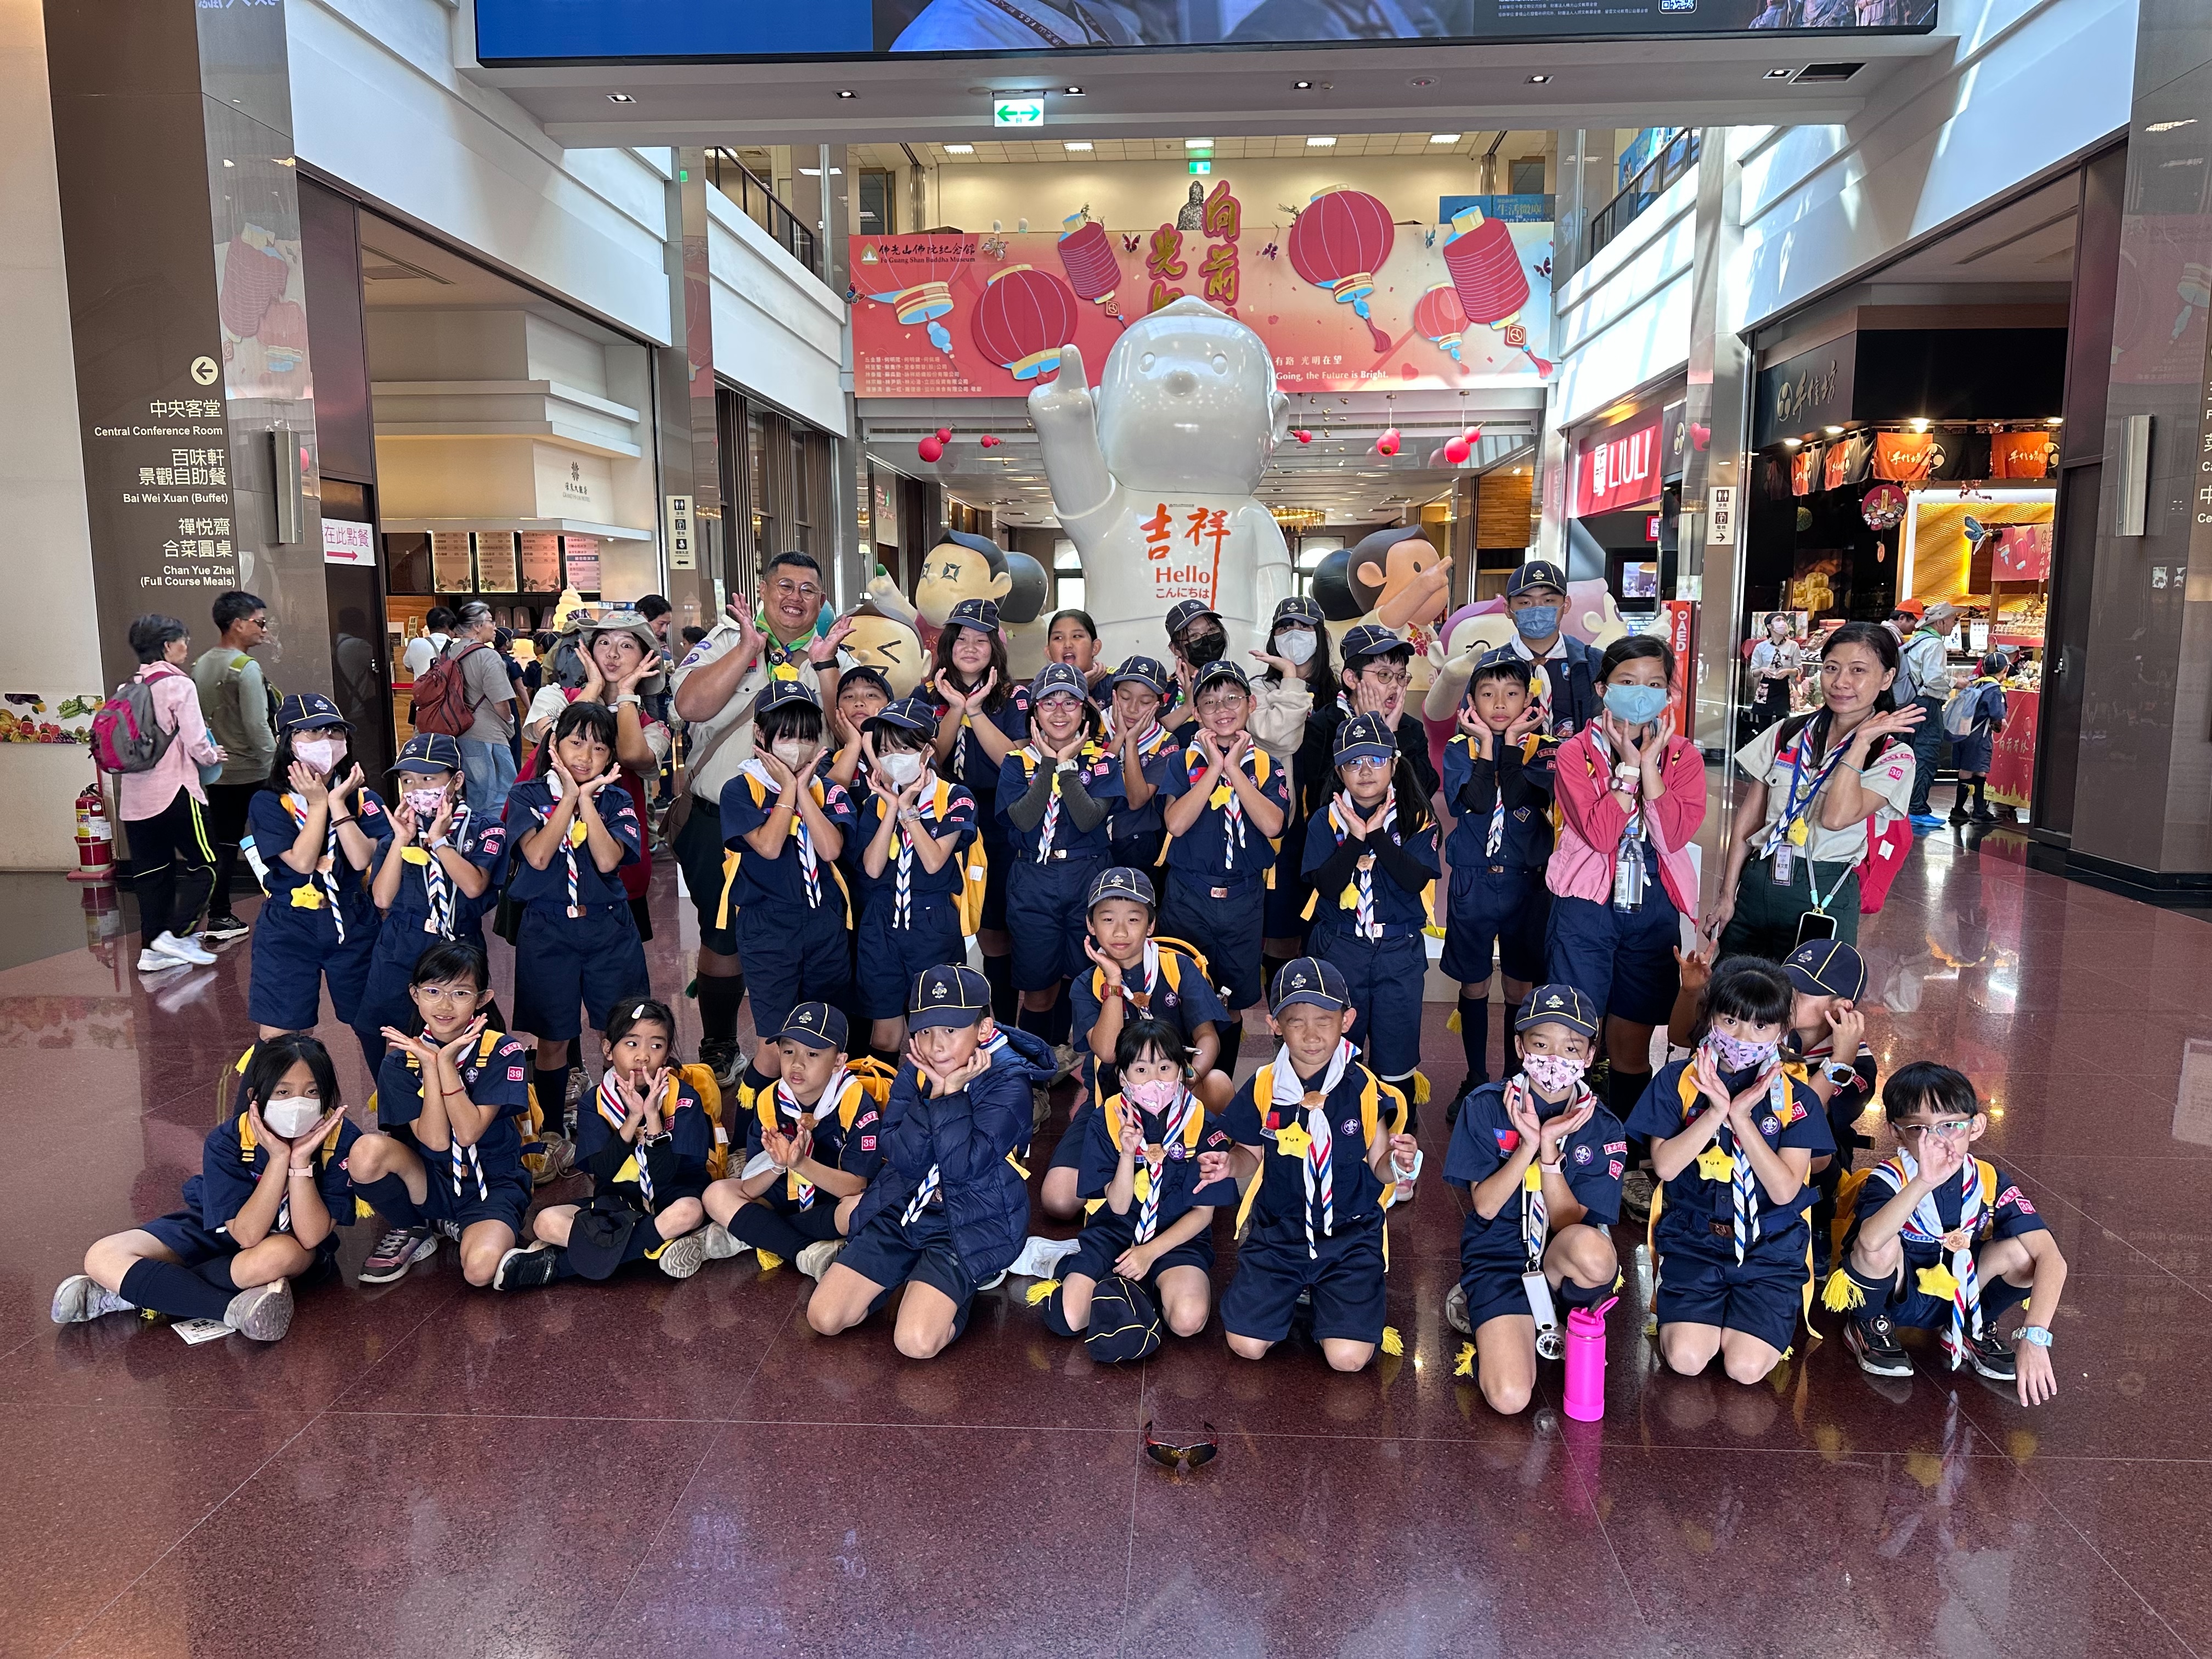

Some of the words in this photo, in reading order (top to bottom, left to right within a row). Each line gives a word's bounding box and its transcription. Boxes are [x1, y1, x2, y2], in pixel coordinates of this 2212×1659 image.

[1275, 356, 1295, 366] 有路
[1301, 356, 1342, 365] 光明在望
[1276, 372, 1304, 382] Going,
[1306, 371, 1319, 380] the
[1322, 371, 1349, 380] Future
[1361, 370, 1389, 381] Bright.
[150, 399, 221, 418] 中央客堂
[94, 426, 131, 437] Central
[132, 426, 190, 436] Conference
[193, 426, 223, 435] Room
[172, 448, 224, 467] 百味軒
[1609, 430, 1651, 488] LIULI
[138, 467, 227, 486] 景觀自助餐
[123, 493, 140, 503] Bai
[142, 493, 161, 503] Wei
[163, 493, 189, 503] Xuan
[191, 493, 228, 505] (Buffet)
[162, 539, 233, 558] 合菜圓桌
[1140, 503, 1231, 611] 吉祥
[163, 566, 189, 575] Chan
[191, 566, 210, 575] Yue
[212, 566, 234, 575] Zhai
[1155, 565, 1211, 584] Hello
[140, 577, 163, 588] (Full
[165, 577, 201, 586] Course
[203, 577, 235, 587] Meals)
[1155, 587, 1210, 599] こんにちは
[1675, 620, 1687, 652] AED
[1889, 769, 1901, 778] 39
[509, 1070, 521, 1078] 39
[863, 1138, 874, 1147] 39
